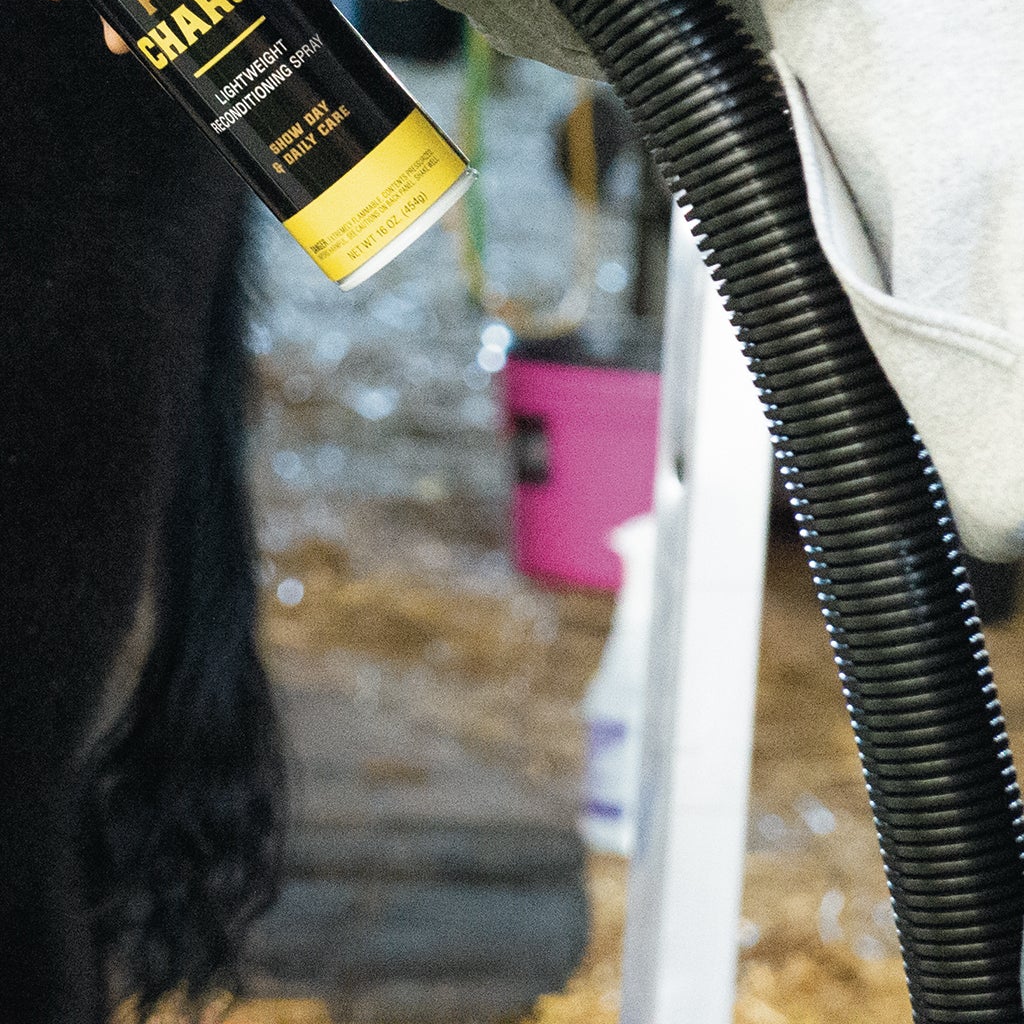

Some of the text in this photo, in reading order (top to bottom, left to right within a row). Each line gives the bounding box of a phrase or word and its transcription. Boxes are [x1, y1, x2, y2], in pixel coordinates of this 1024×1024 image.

[210, 33, 324, 134] RECONDITIONING SPRAY
[214, 38, 288, 105] LIGHTWEIGHT
[269, 99, 330, 155] SHOW DAY
[271, 104, 351, 174] & DAILY CARE
[354, 208, 381, 233] CAUTIONS
[377, 203, 387, 213] ON
[384, 191, 400, 206] BACK
[413, 164, 430, 181] SHAKE
[380, 172, 409, 198] CONTENTS
[346, 244, 363, 261] NET
[360, 233, 377, 249] WT
[375, 224, 388, 237] 16
[398, 190, 430, 218] (454g)
